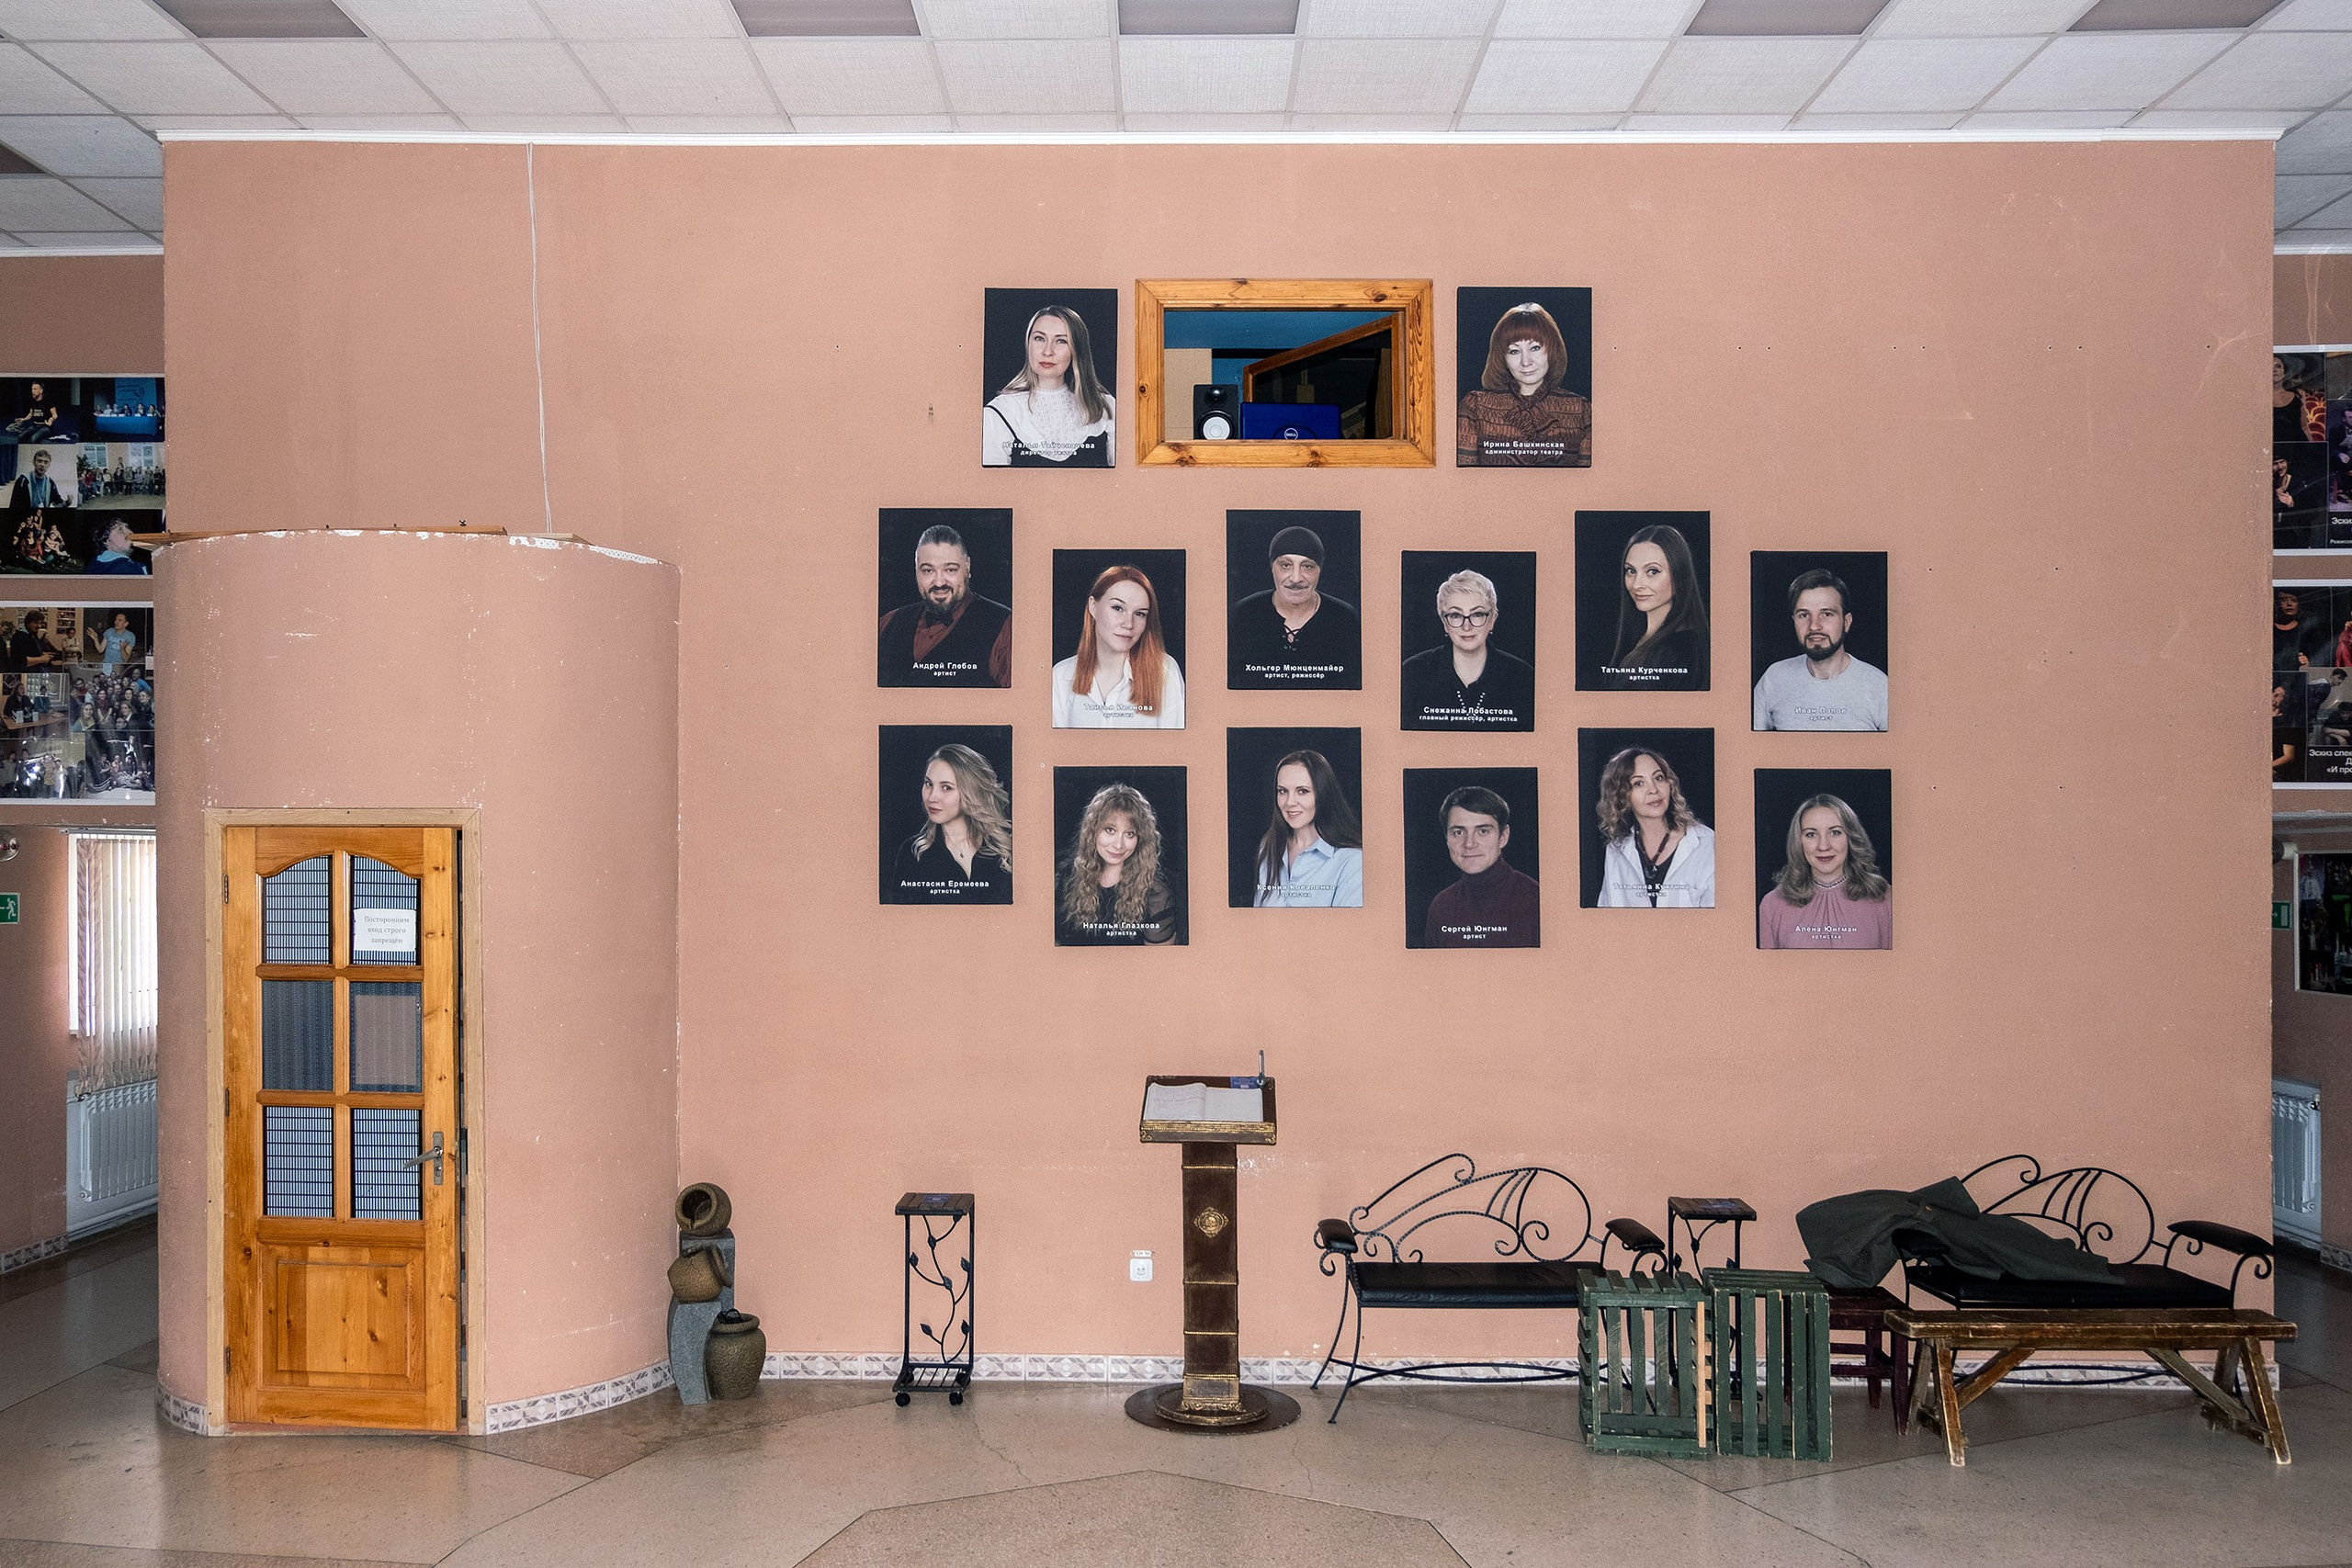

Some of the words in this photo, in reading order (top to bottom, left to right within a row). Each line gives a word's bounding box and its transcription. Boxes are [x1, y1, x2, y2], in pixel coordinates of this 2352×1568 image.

[1484, 441, 1510, 449] Ирина
[1513, 441, 1564, 449] Башкинская
[913, 662, 944, 671] Андрей
[1283, 665, 1344, 673] Мюнценмайер
[1468, 707, 1513, 716] Лобастова
[364, 916, 410, 924] Посторонним
